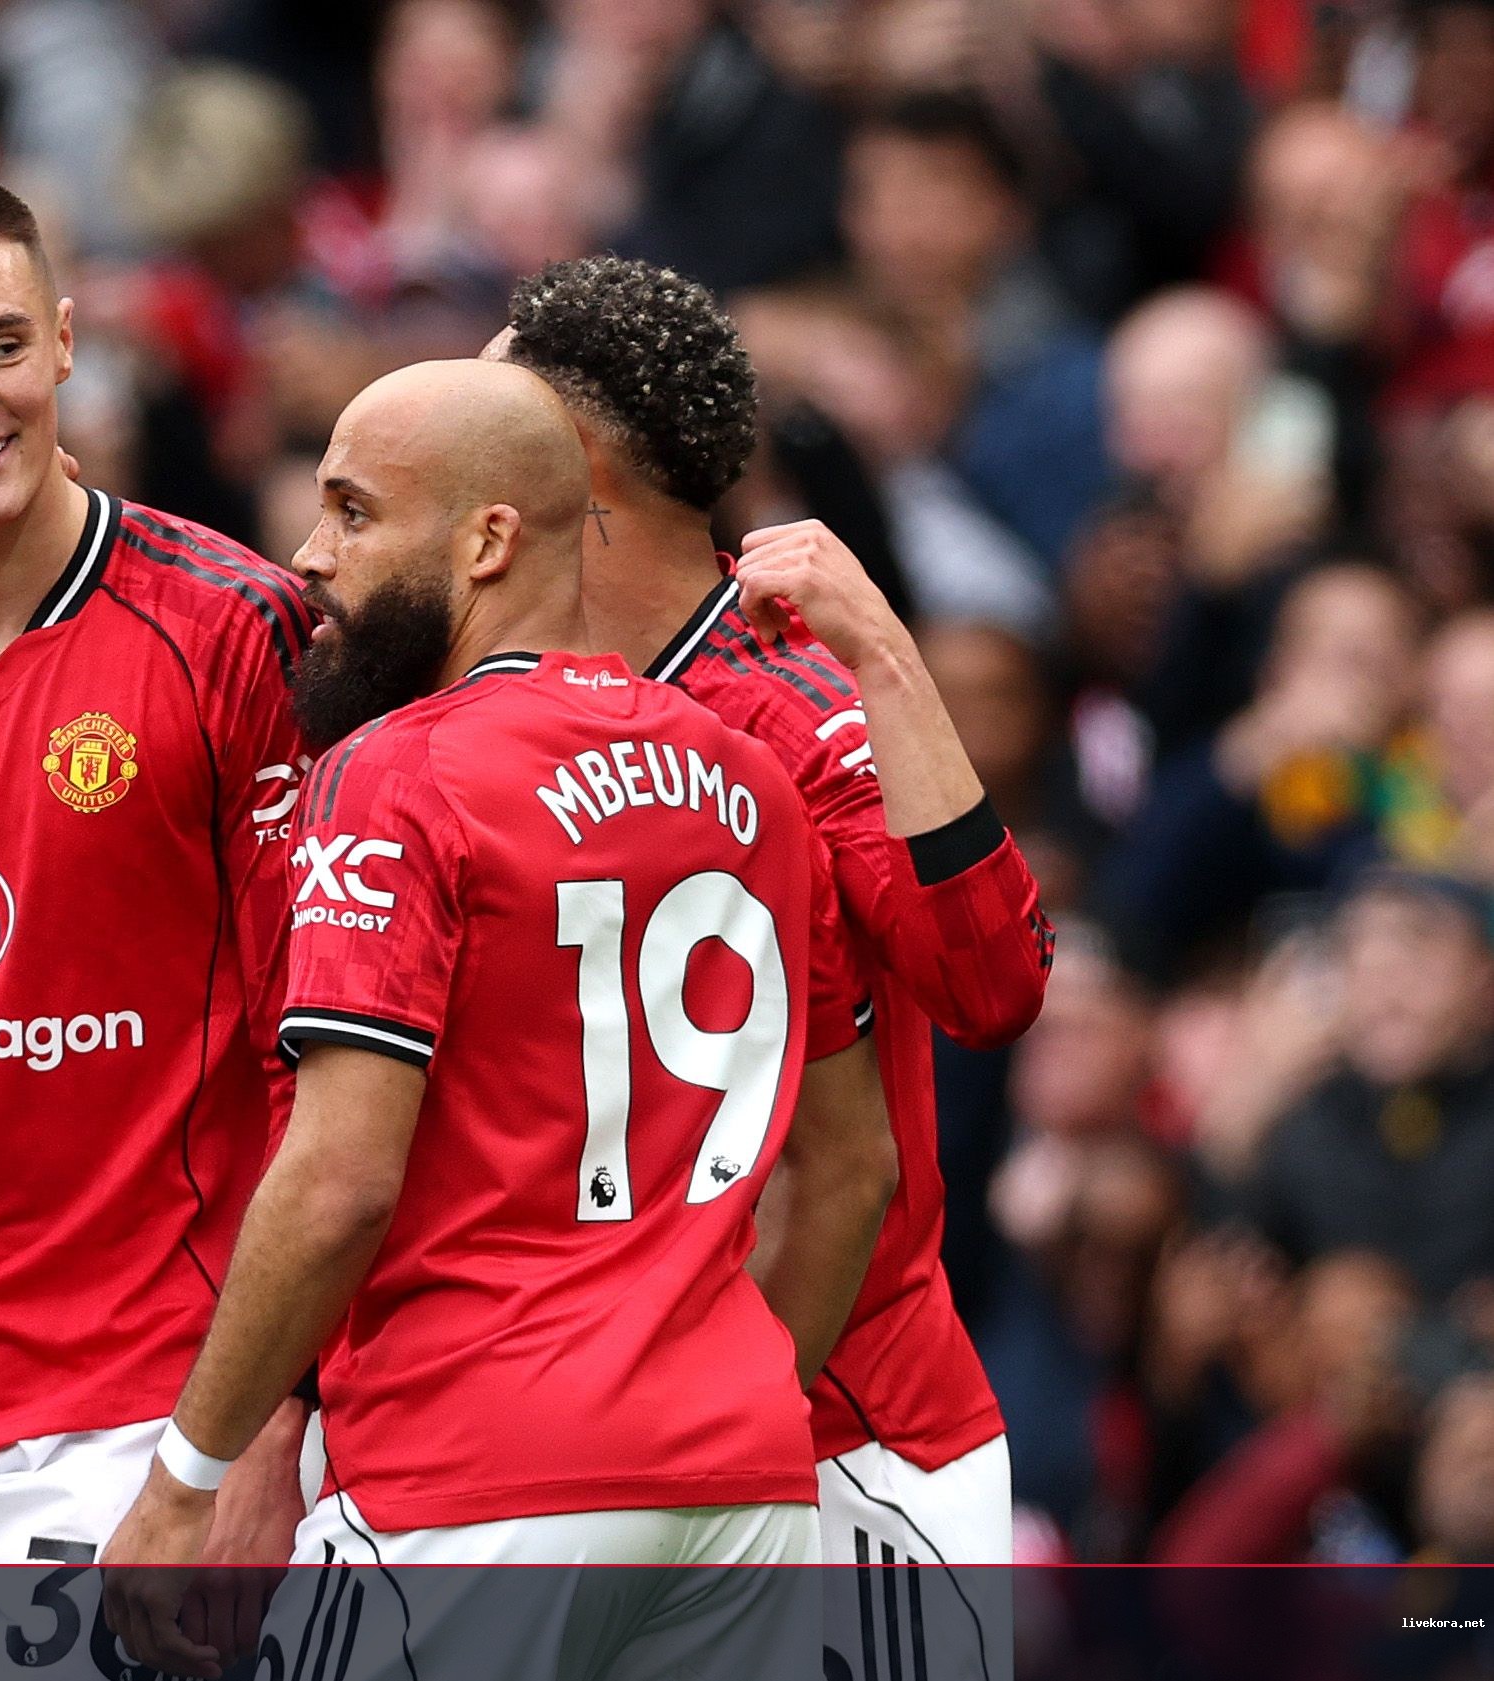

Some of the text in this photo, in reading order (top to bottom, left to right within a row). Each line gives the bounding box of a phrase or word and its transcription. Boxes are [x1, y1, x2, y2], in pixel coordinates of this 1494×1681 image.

[55, 720, 131, 755] MANCHESTER
[61, 786, 115, 806] UNITED
[536, 740, 758, 846] MBEUMO
[291, 904, 392, 933] HNOLOGY
[556, 871, 789, 1222] 19
